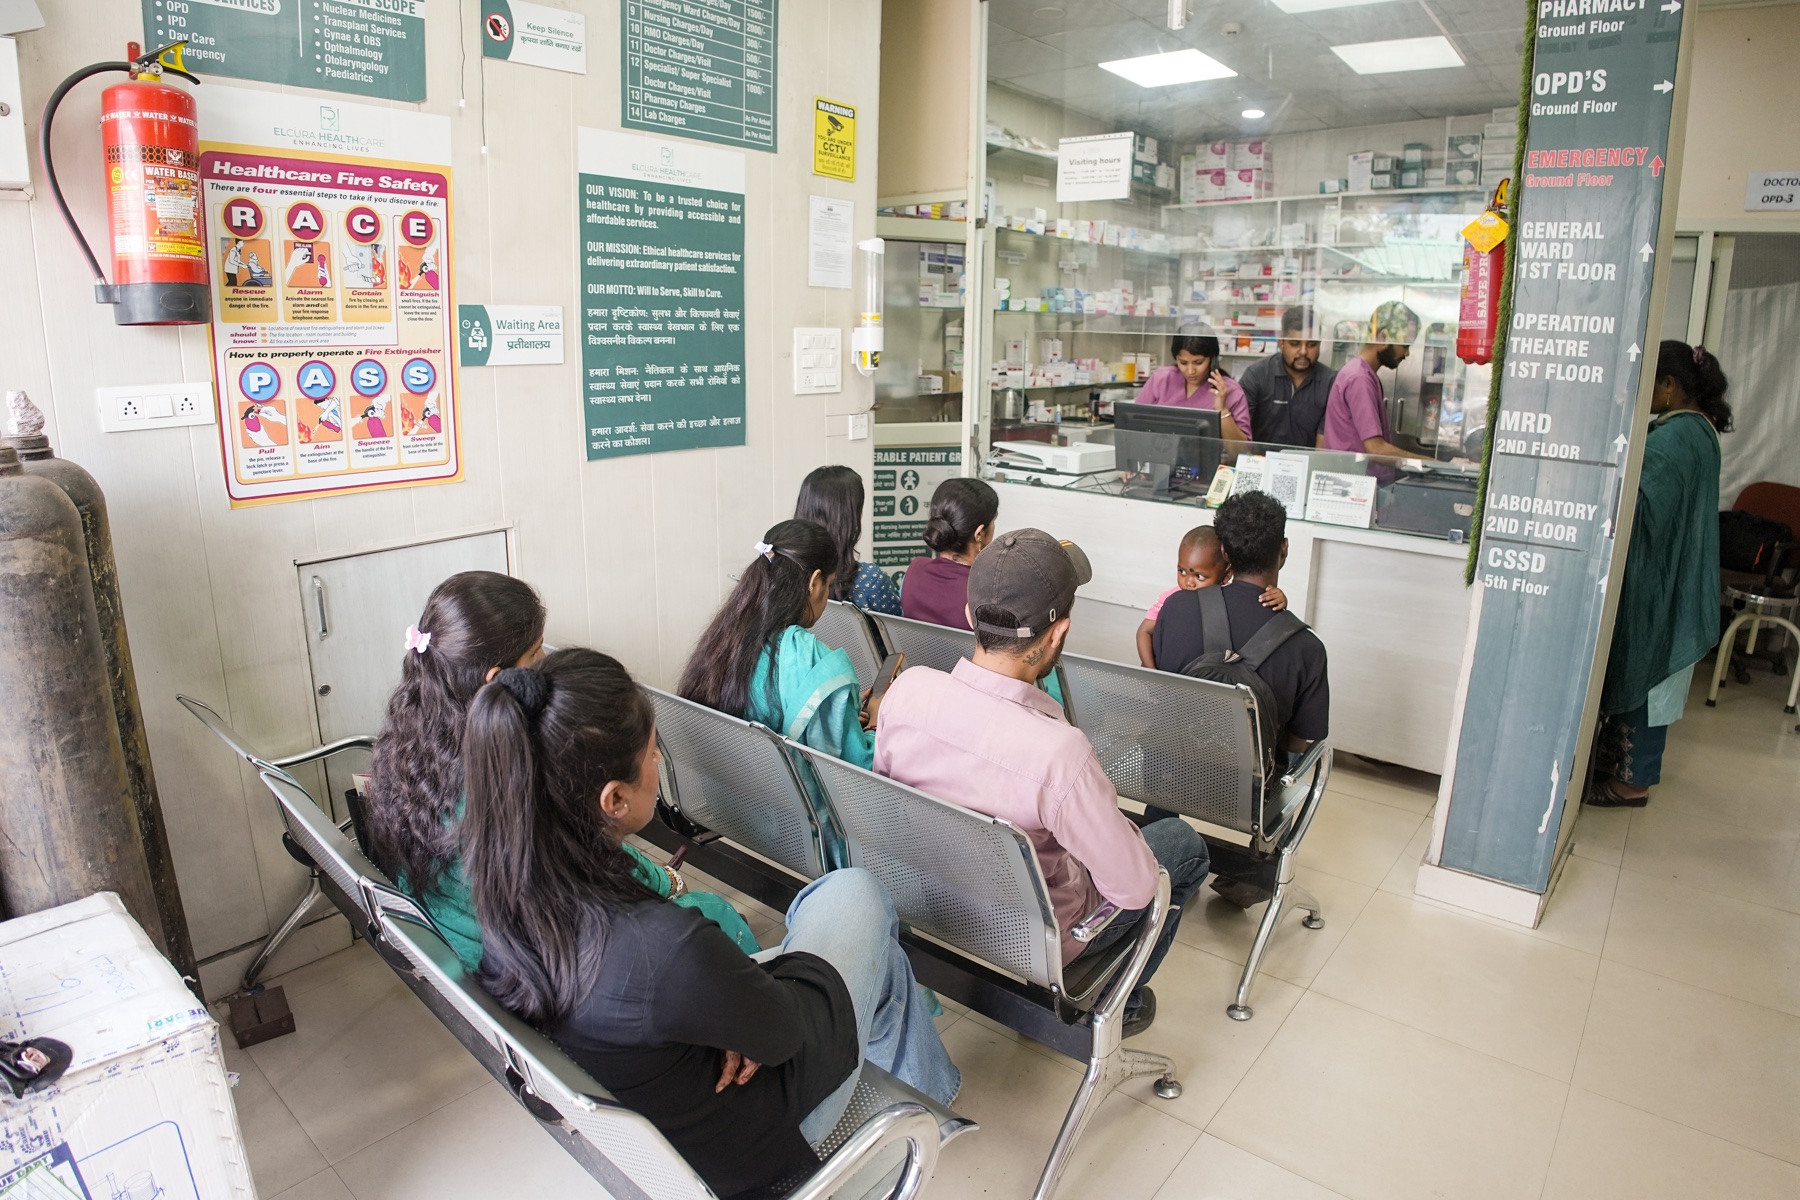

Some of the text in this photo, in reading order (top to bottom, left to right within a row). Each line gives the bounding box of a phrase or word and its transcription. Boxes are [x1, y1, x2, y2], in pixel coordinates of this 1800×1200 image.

[166, 1, 189, 14] OPD
[323, 2, 402, 26] Nuclear Medicines
[168, 15, 186, 27] IPD
[323, 15, 407, 39] Transplant Services
[527, 23, 573, 38] Keep Silence
[644, 10, 713, 37] Nursing Charges/Day
[1538, 19, 1624, 38] Ground Floor
[192, 33, 215, 46] Care
[324, 28, 381, 47] Gynae & OBS
[644, 26, 704, 51] RMO Charges/Day
[324, 41, 382, 61] Opthalmology
[644, 43, 711, 67] Doctor Charges/Visit
[324, 54, 389, 74] Otolaryngology
[644, 60, 732, 88] Specialist/ Super Specialist
[325, 67, 373, 83] Paediatrics
[644, 76, 711, 98] Doctor Charges/Visit
[644, 92, 706, 113] Pharmacy Charges
[818, 101, 854, 117] WARNING
[1532, 101, 1617, 116] Ground Floor
[142, 112, 168, 120] WATER
[644, 109, 686, 125] Lab Charges
[273, 127, 384, 147] ELCURA HEALTHCARE
[293, 139, 343, 149] ENHANCING
[818, 151, 850, 161] SURVEILLANCE
[823, 142, 847, 154] CCTV
[1528, 147, 1648, 168] EMERGENCY
[145, 167, 175, 177] WATER
[213, 161, 439, 195] Healthcare Fire Safety
[1526, 174, 1613, 187] Ground Floor
[210, 183, 234, 192] There
[252, 186, 278, 194] four
[280, 188, 315, 197] essential
[317, 192, 338, 200] steps
[389, 197, 418, 206] discover
[586, 184, 604, 195] OUR
[609, 187, 639, 199] VISION:
[643, 191, 651, 201] To
[656, 192, 665, 202] be
[678, 195, 702, 207] trusted
[706, 199, 728, 210] choice
[732, 202, 741, 211] for
[1762, 194, 1793, 203] OPD-3
[231, 206, 426, 237] R A C E
[587, 199, 740, 224] healthcare by providing accessible and
[587, 214, 659, 229] affordable services.
[1522, 222, 1604, 240] GENERAL
[1521, 242, 1574, 259] WARD
[1520, 262, 1616, 281] 1ST FLOOR
[588, 284, 723, 298] OUR MOTTO: Will to Serve, Skill to Cure.
[1477, 280, 1488, 318] SAFE
[587, 307, 740, 321] हमारा दृष्टिकोण: सुलभ और किफायती सेवाएं
[1513, 312, 1615, 334] OPERATION
[496, 320, 560, 331] Waiting Area
[507, 338, 550, 350] प्रतीक्षालय
[1511, 337, 1589, 357] THEATRE
[271, 350, 314, 360] properly
[317, 350, 353, 358] operate
[249, 367, 429, 392] P A S S
[1509, 361, 1603, 383] 1ST FLOOR
[1500, 410, 1551, 434] MRD
[910, 452, 947, 462] PATIENT
[1496, 439, 1580, 460] 2ND FLOOR
[1489, 493, 1597, 521] LABORATORY
[1486, 516, 1577, 542] 2ND FLOOR
[1488, 547, 1546, 573] CSSD
[1484, 574, 1549, 596] 5th Floor
